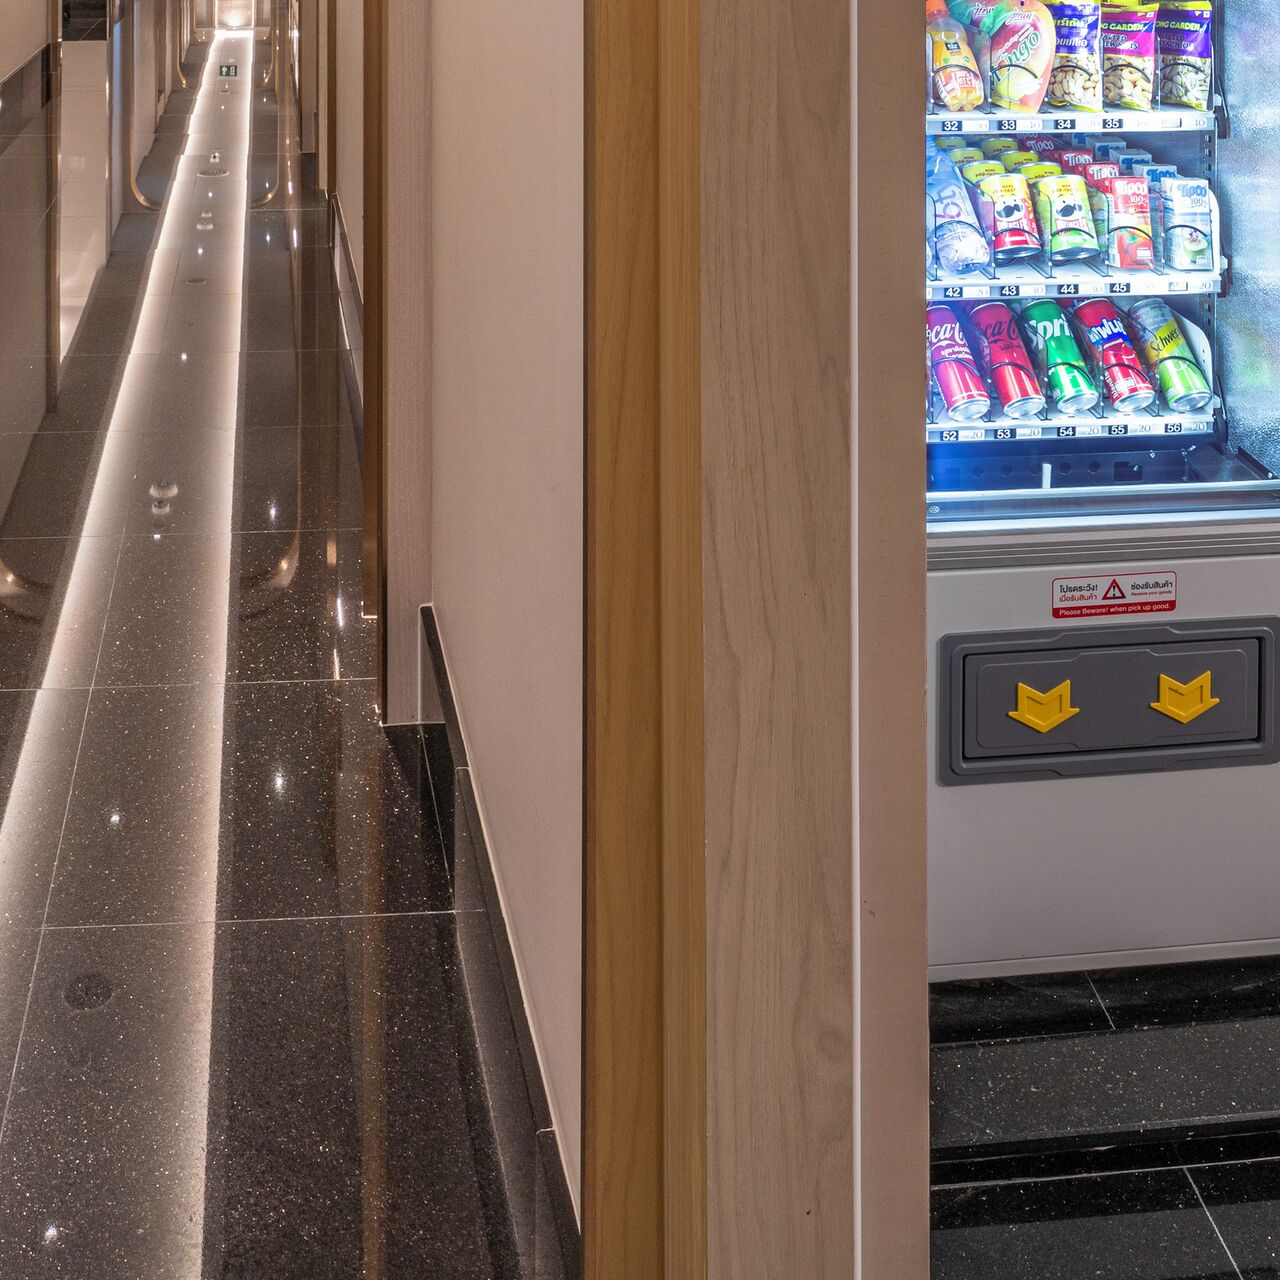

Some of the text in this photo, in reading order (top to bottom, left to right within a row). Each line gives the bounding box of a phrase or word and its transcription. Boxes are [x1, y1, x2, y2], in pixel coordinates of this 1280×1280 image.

[943, 121, 959, 131] 32
[1001, 121, 1016, 130] 33
[1057, 119, 1072, 129] 34
[1104, 119, 1119, 129] 35
[1176, 184, 1208, 198] Tipco
[945, 287, 961, 297] 42
[1002, 286, 1017, 296] 43
[1060, 284, 1076, 294] 44
[1112, 283, 1127, 293] 45
[1059, 426, 1073, 436] 54
[1087, 427, 1100, 435] 20
[1111, 425, 1125, 434] 55
[1166, 423, 1181, 432] 56
[942, 431, 957, 441] 52
[996, 429, 1011, 438] 53
[1059, 608, 1081, 616] Please
[1110, 605, 1127, 613] when
[1128, 603, 1142, 612] pick
[1152, 602, 1171, 611] good.
